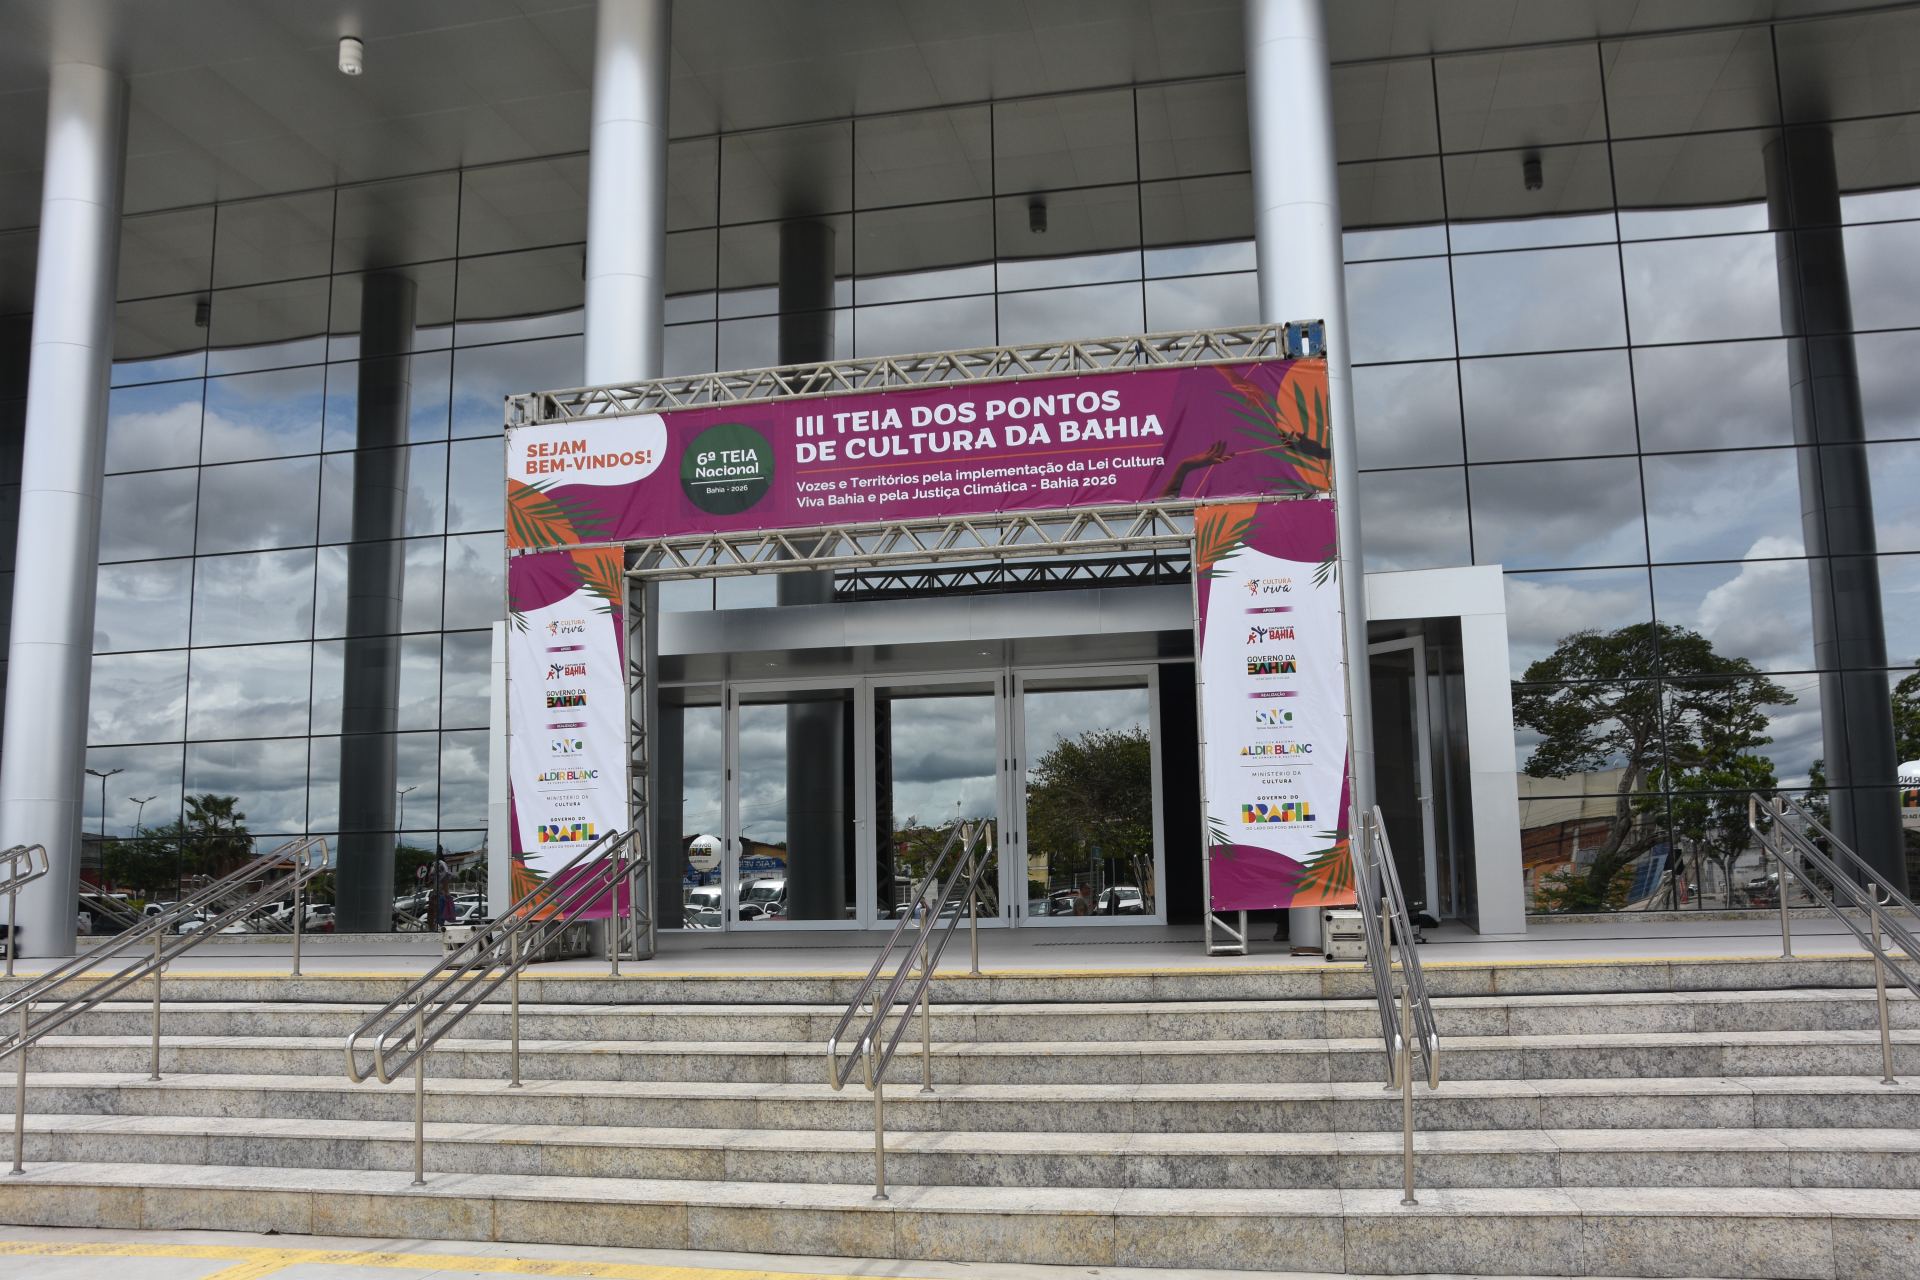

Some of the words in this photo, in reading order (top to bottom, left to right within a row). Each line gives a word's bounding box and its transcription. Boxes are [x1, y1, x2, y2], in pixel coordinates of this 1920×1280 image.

[796, 415, 824, 437] III
[833, 408, 902, 433] TEIA
[910, 402, 977, 428] DOS
[985, 390, 1121, 422] PONTOS
[796, 441, 837, 463] DE
[845, 427, 997, 460] CULTURA
[1004, 422, 1051, 447] DA
[1059, 414, 1164, 443] BAHIA
[527, 439, 587, 458] SEJAM
[720, 448, 758, 464] TEIA
[526, 449, 652, 475] BEM-VINDOS!
[695, 462, 759, 479] Nacional
[796, 479, 836, 492] Vozes
[838, 480, 848, 489] e
[850, 472, 919, 488] Territórios
[922, 471, 952, 486] pela
[955, 461, 1064, 481] implementação
[1067, 458, 1084, 472] da
[1088, 457, 1109, 471] Lei
[1112, 454, 1165, 469] Cultura
[706, 486, 725, 494] Bahia
[731, 484, 748, 492] 2026
[797, 494, 826, 508] Viva
[828, 491, 865, 506] Bahia
[868, 493, 876, 502] e
[879, 487, 909, 503] pela
[912, 483, 960, 501] Justiça
[963, 478, 1028, 496] Climática
[1041, 475, 1079, 490] Bahia
[1082, 473, 1117, 487] 2026
[1264, 584, 1292, 593] viva
[562, 625, 585, 634] viva
[1269, 629, 1295, 640] BAHIA
[565, 666, 586, 676] BAHIA
[1248, 661, 1296, 675] BAHIA
[547, 695, 586, 708] BAHIA
[1240, 745, 1273, 756] ALDIR
[1275, 744, 1312, 755] BLANC
[538, 772, 565, 781] ALDIR
[567, 770, 598, 780] BLANC
[1242, 802, 1316, 823] BRASIL
[538, 823, 599, 843] BRASIL
